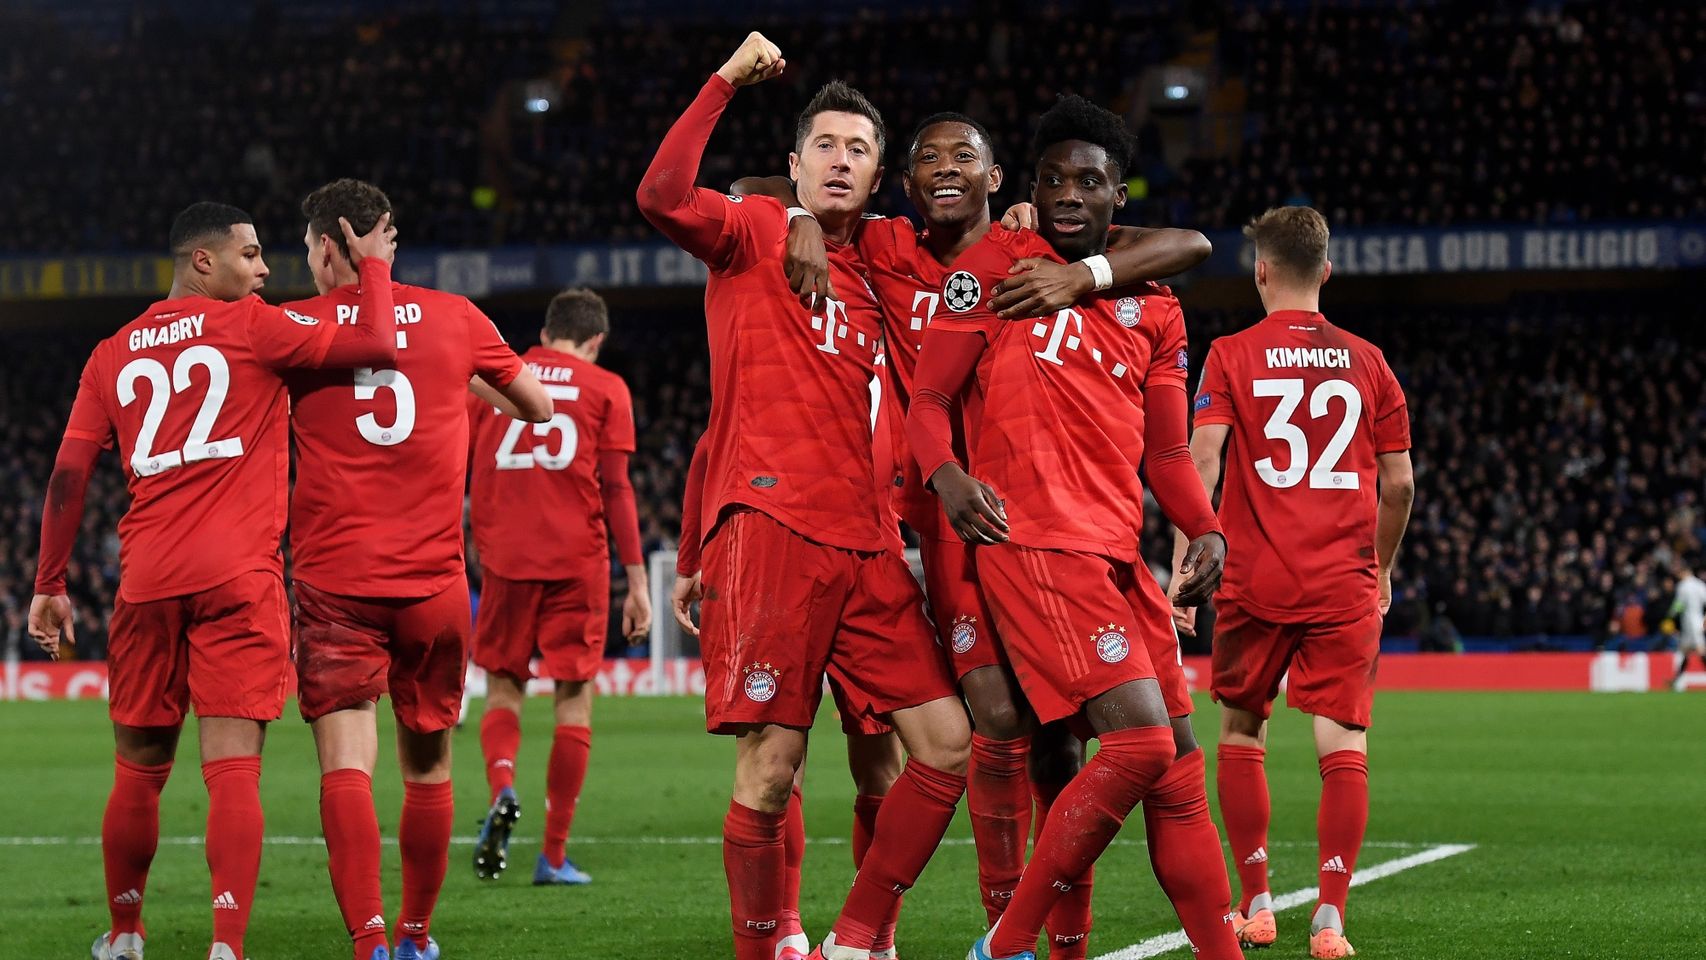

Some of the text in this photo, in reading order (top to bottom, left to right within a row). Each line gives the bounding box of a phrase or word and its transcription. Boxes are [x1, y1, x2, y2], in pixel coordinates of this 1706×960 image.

[1439, 233, 1509, 271] OUR
[1523, 230, 1658, 270] RELIGIO
[129, 313, 205, 351] GNABRY
[336, 303, 422, 325] PRD
[528, 363, 574, 383] ÜLLER
[1265, 348, 1350, 369] KIMMICH
[353, 330, 416, 446] 5
[116, 344, 244, 477] 22
[494, 384, 580, 470] 25
[1252, 378, 1362, 490] 32
[746, 920, 776, 930] FCB
